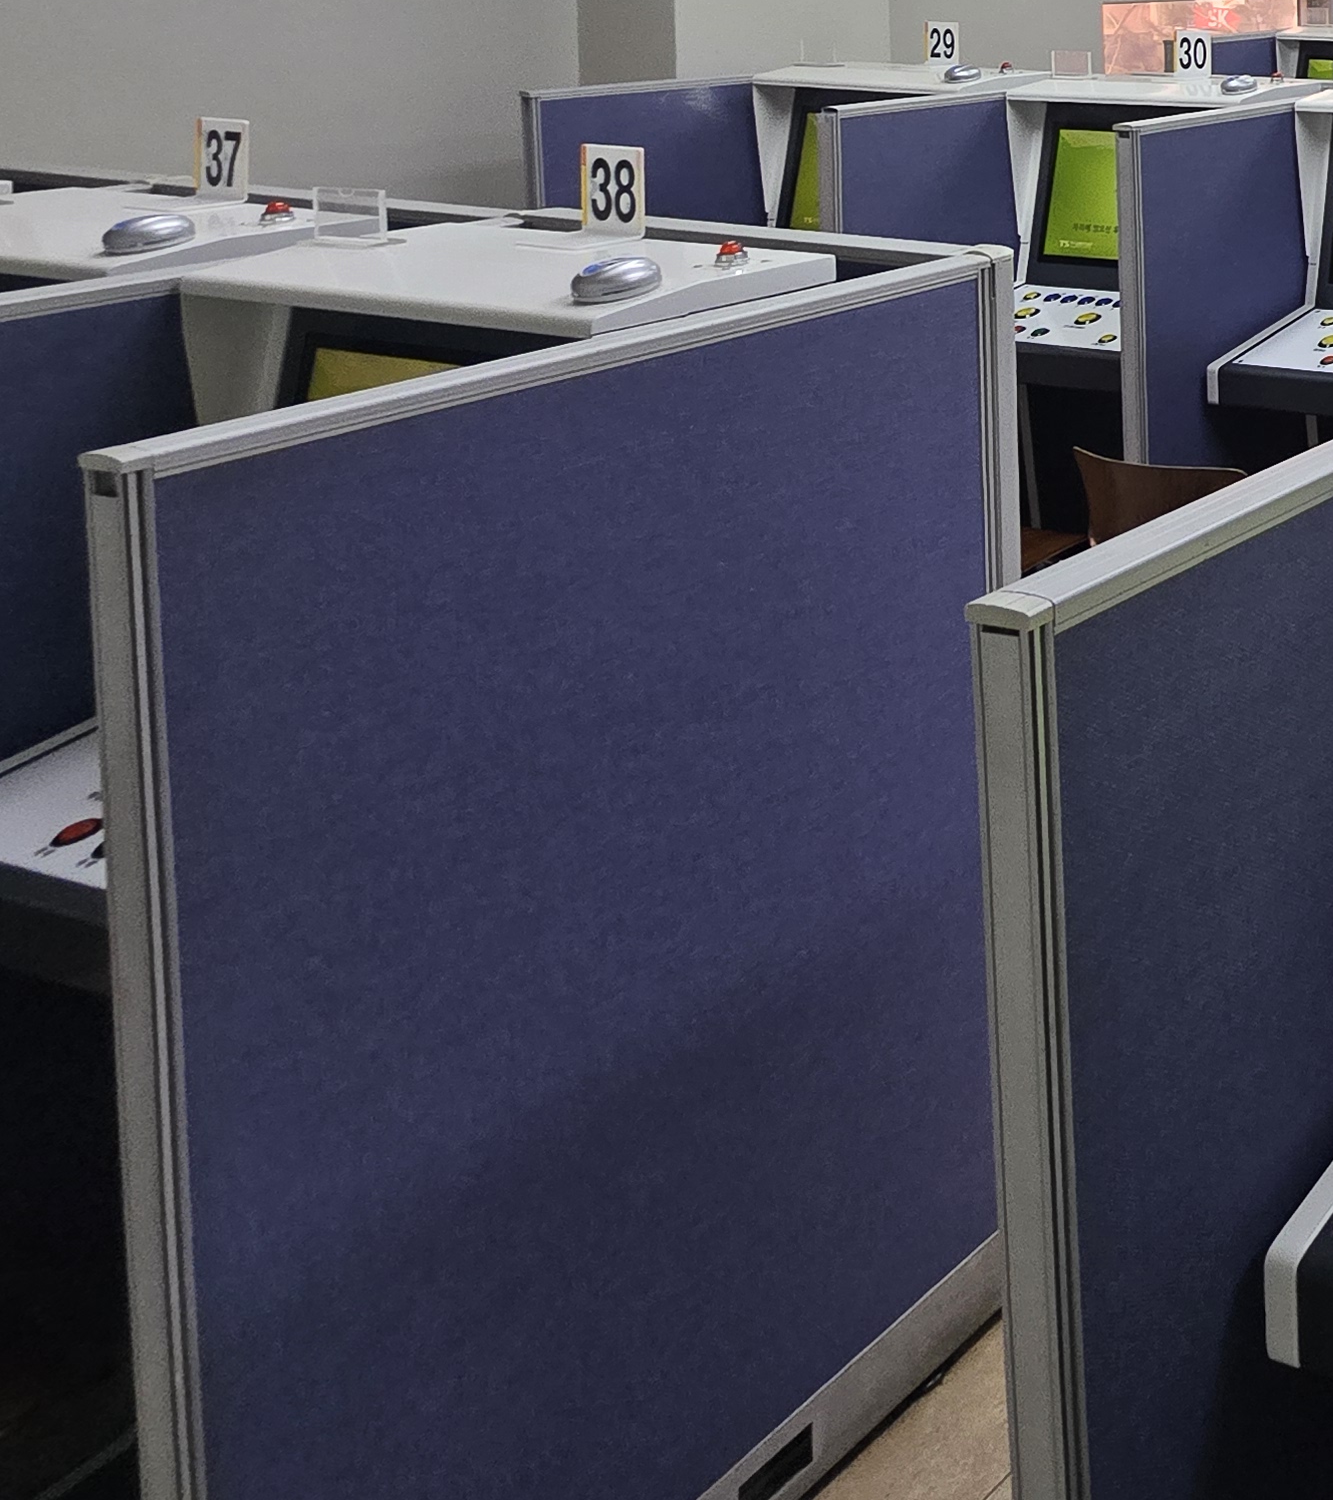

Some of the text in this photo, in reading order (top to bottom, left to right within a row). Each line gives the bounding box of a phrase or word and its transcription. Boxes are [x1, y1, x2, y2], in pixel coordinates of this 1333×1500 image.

[929, 28, 955, 60] 29
[1179, 37, 1206, 69] 30
[206, 130, 241, 187] 37
[591, 158, 636, 223] 38
